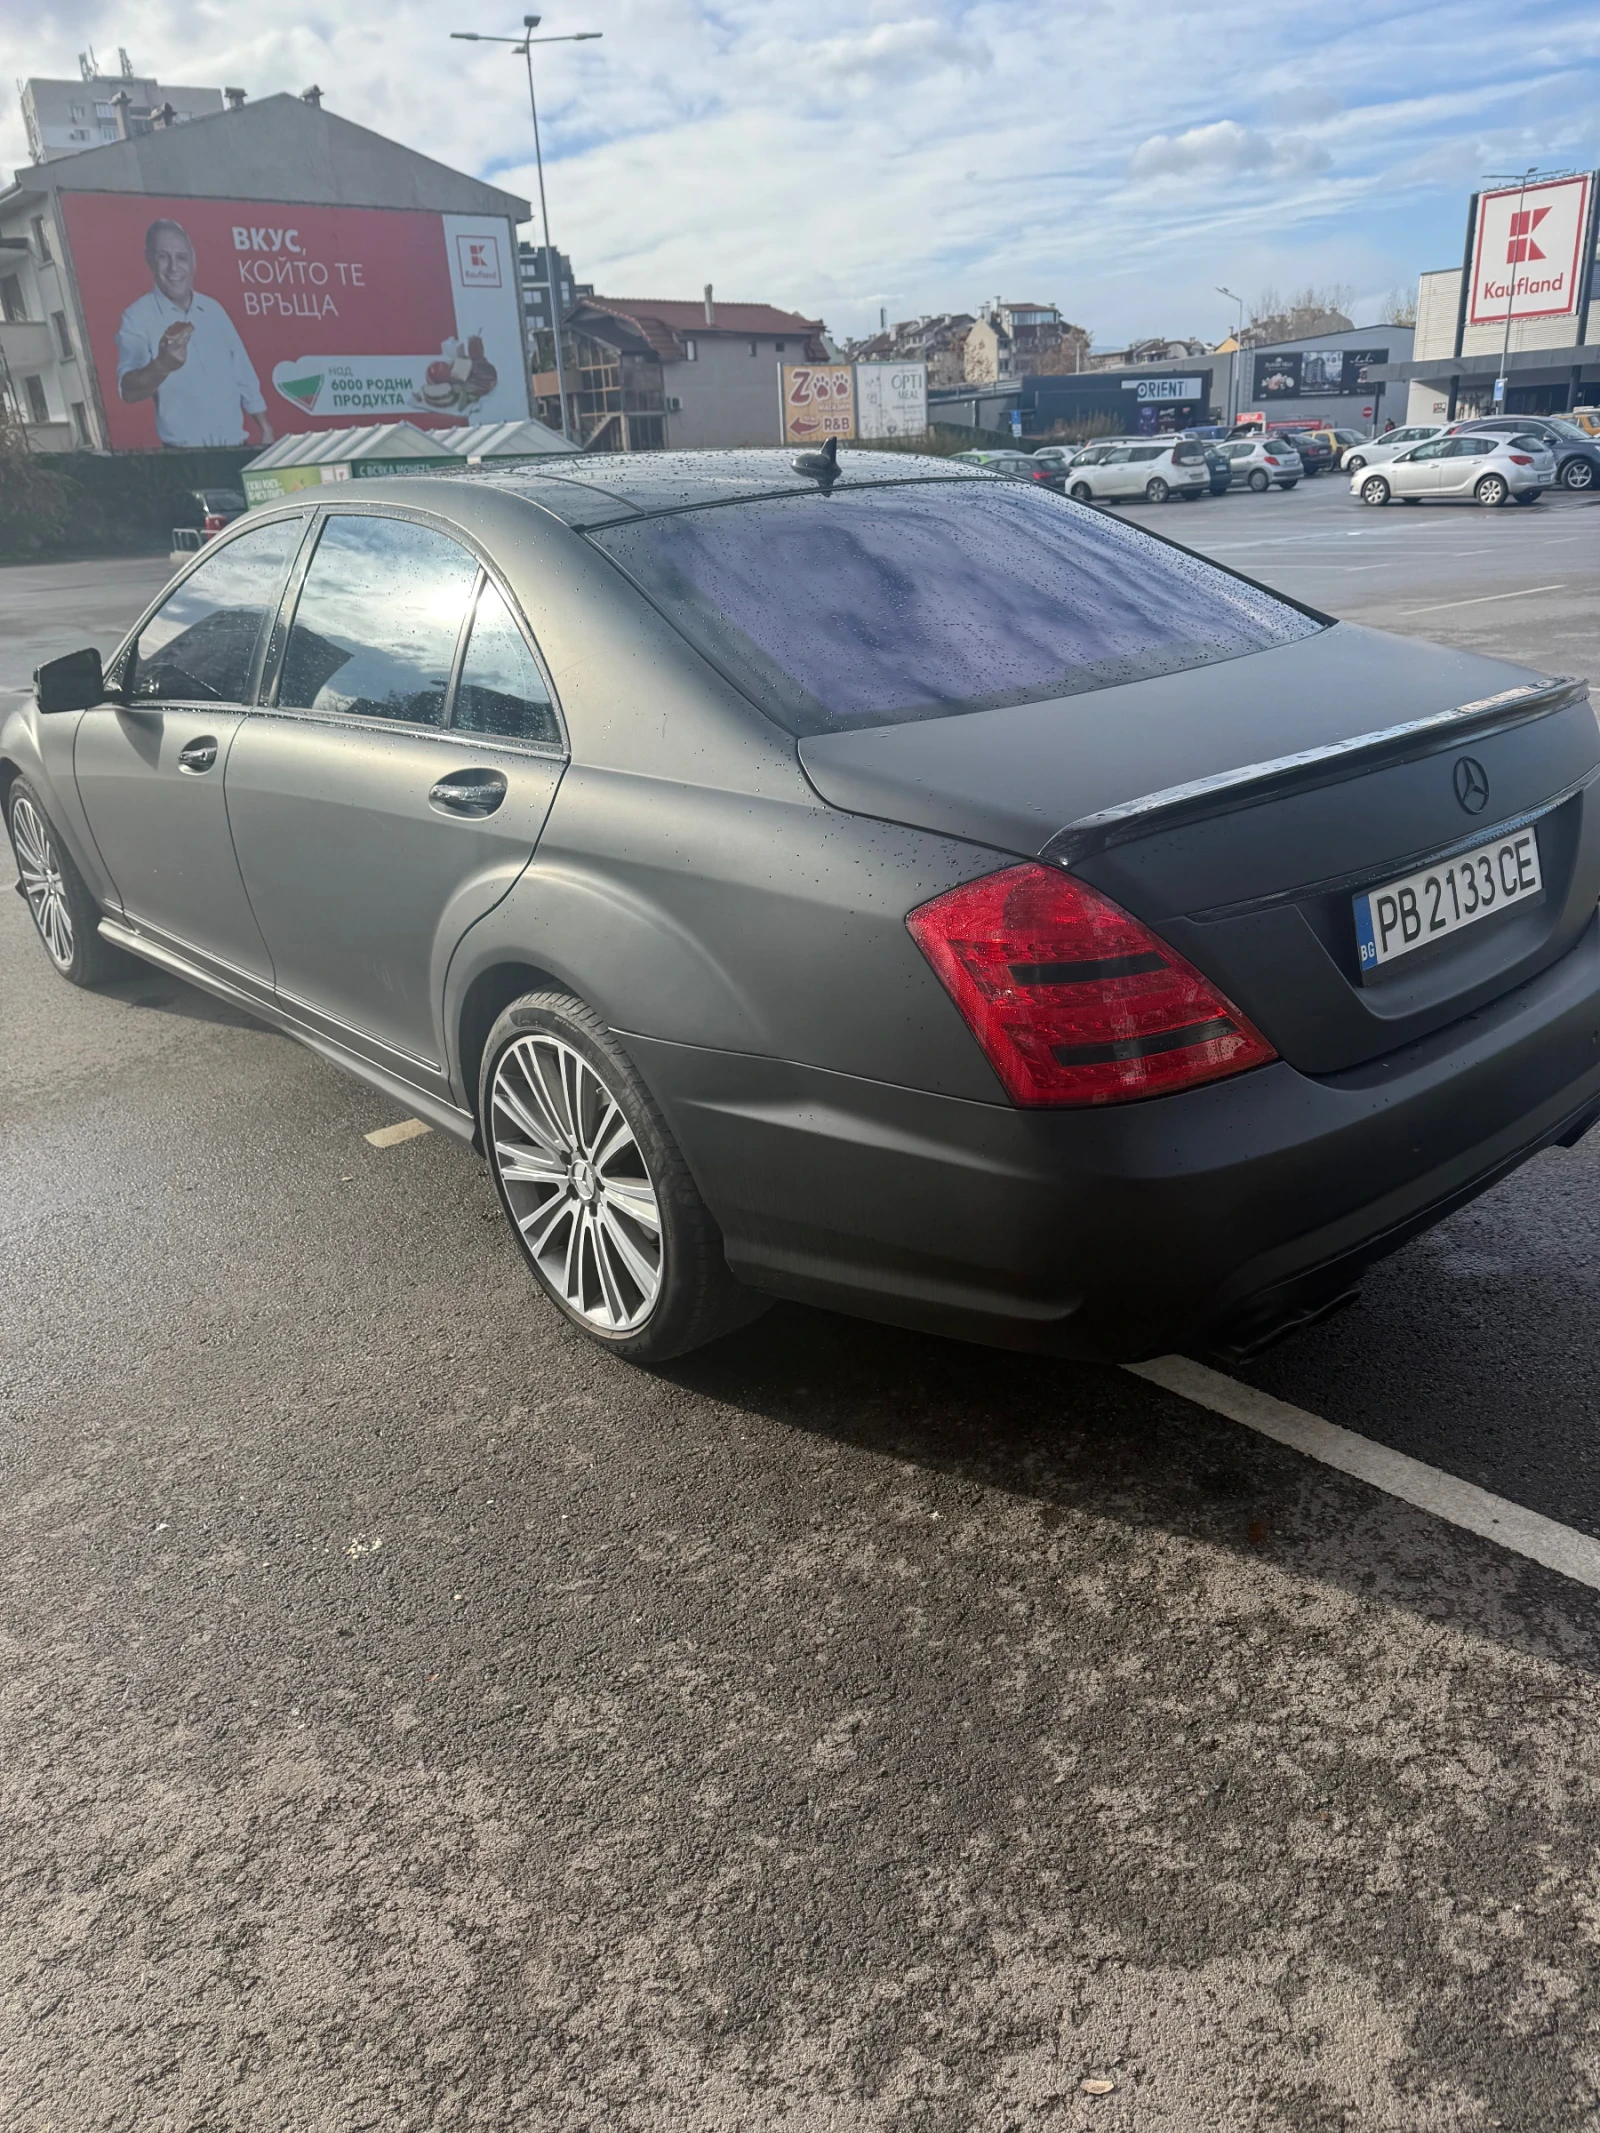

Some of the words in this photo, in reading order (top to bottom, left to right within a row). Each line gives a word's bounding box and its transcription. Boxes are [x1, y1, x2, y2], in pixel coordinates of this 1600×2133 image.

[232, 225, 306, 257] ВКУС,
[238, 255, 328, 286] КОЙТО
[335, 262, 365, 287] ТЕ
[1483, 272, 1564, 300] Kaufland
[244, 291, 339, 320] ВРЪЩА
[331, 379, 363, 391] 6000
[366, 377, 413, 392] РОДНИ
[891, 374, 922, 389] OPTI
[1136, 381, 1185, 399] ORIENT
[333, 393, 405, 408] ПРОДУКТА
[897, 390, 919, 400] MEAL
[823, 417, 850, 431] R&B
[1376, 887, 1421, 953] PB
[1424, 855, 1496, 932] 2133
[1498, 837, 1536, 897] CE
[1360, 941, 1375, 962] BG
